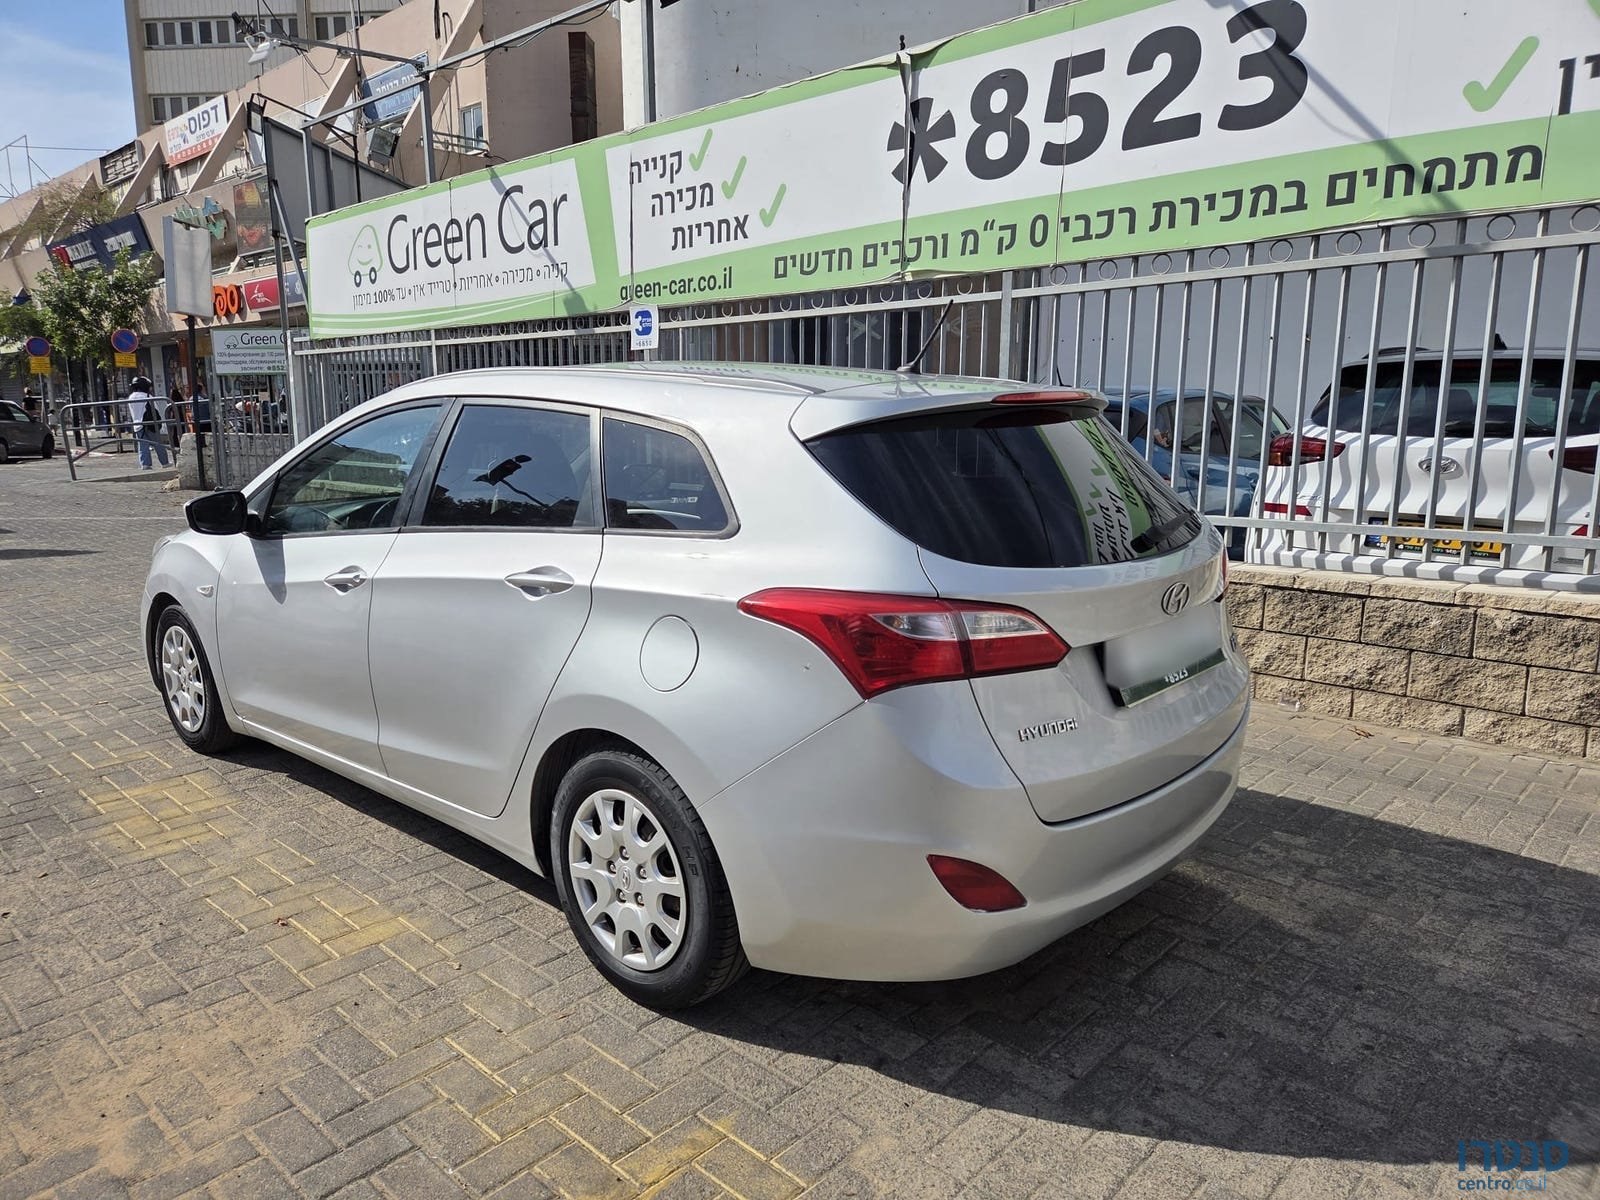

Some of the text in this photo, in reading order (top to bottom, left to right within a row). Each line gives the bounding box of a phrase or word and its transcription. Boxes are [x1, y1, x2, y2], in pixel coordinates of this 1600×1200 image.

[188, 104, 219, 135] דפוס
[630, 150, 683, 185] קנייה
[1325, 143, 1543, 208] מתמחים
[651, 182, 714, 217] מכירה
[1149, 178, 1309, 231] במכירת
[387, 185, 569, 274] Green Car
[671, 214, 750, 252] אחריות
[1030, 213, 1049, 248] 0
[1059, 203, 1138, 243] רכבי
[774, 246, 853, 280] חדשים
[860, 226, 949, 269] ורכבים
[352, 261, 569, 310] קניה מכירה אחריות טרייד אין עד 100% מימון
[620, 266, 733, 301] green-car.co.il
[240, 332, 277, 346] Green
[1018, 717, 1078, 742] HYUNDAI
